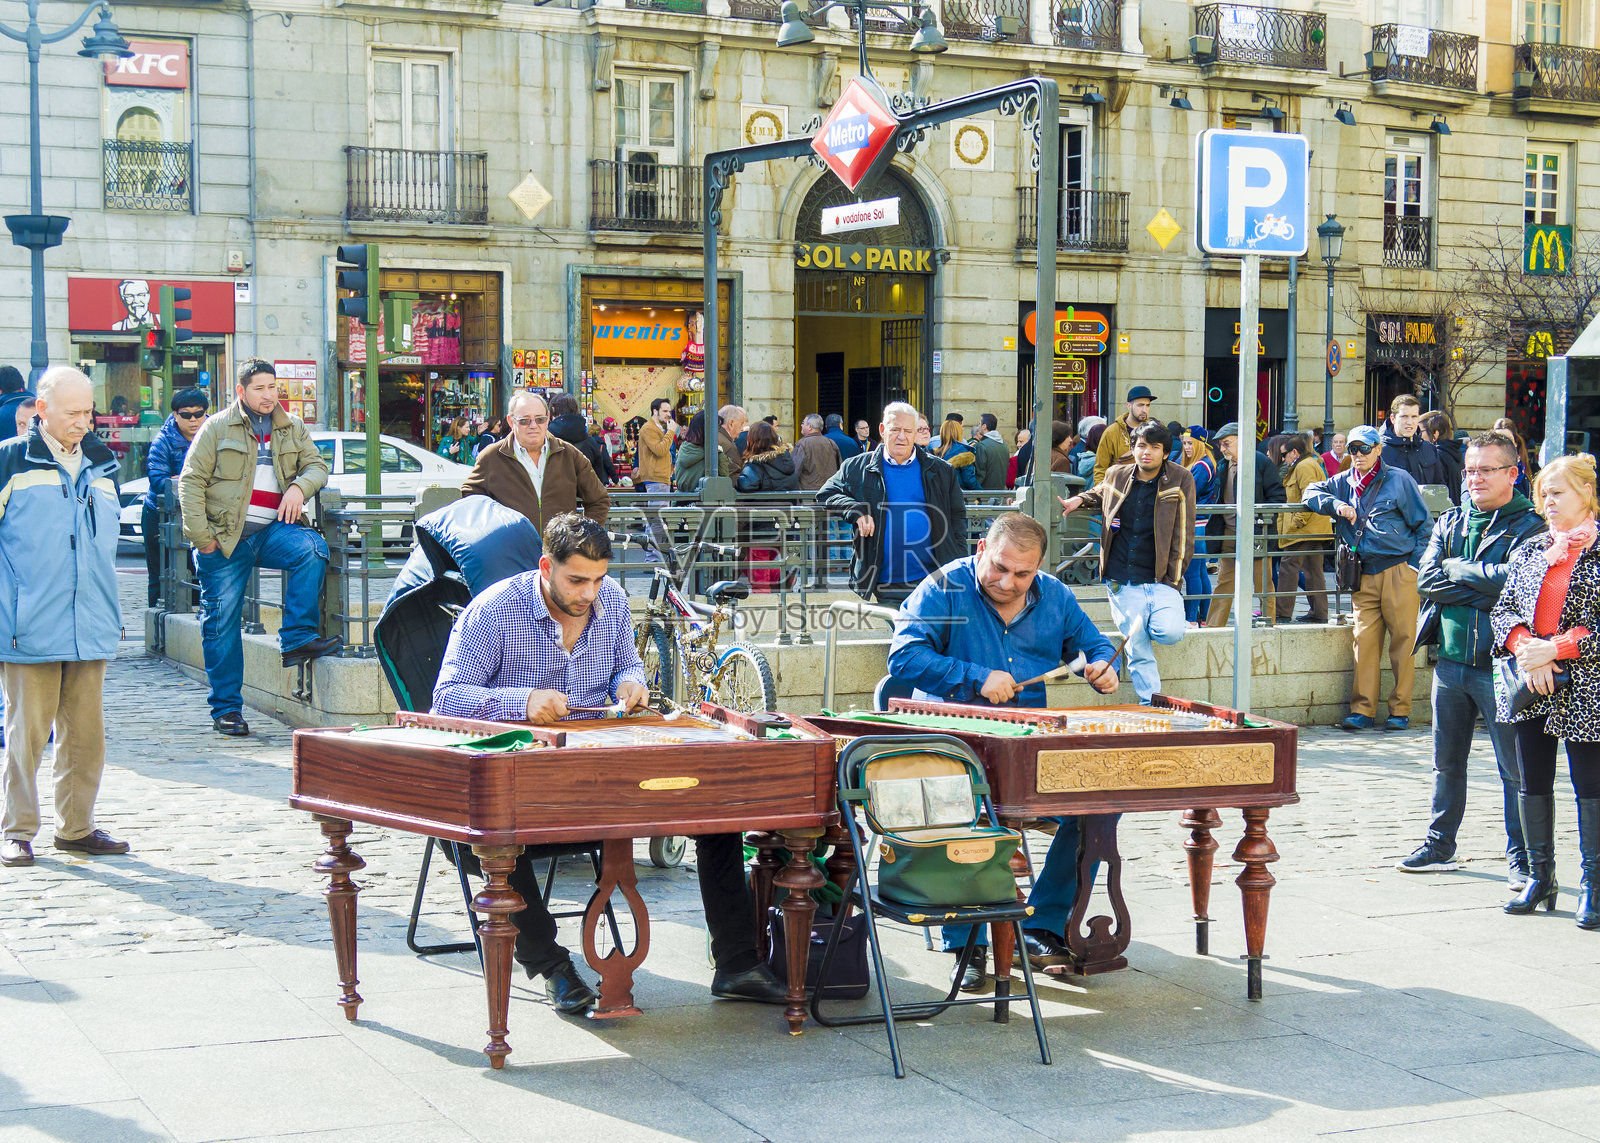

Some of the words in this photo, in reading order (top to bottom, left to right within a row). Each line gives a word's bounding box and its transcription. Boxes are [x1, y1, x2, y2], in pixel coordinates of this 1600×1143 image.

[117, 53, 179, 76] KFC
[830, 122, 866, 148] Metro
[1227, 146, 1287, 237] P
[842, 210, 872, 224] vodafone
[873, 208, 885, 219] Sol
[796, 245, 847, 268] SOL
[865, 247, 933, 272] PARK
[1405, 322, 1436, 344] PARK
[97, 430, 121, 439] KFC
